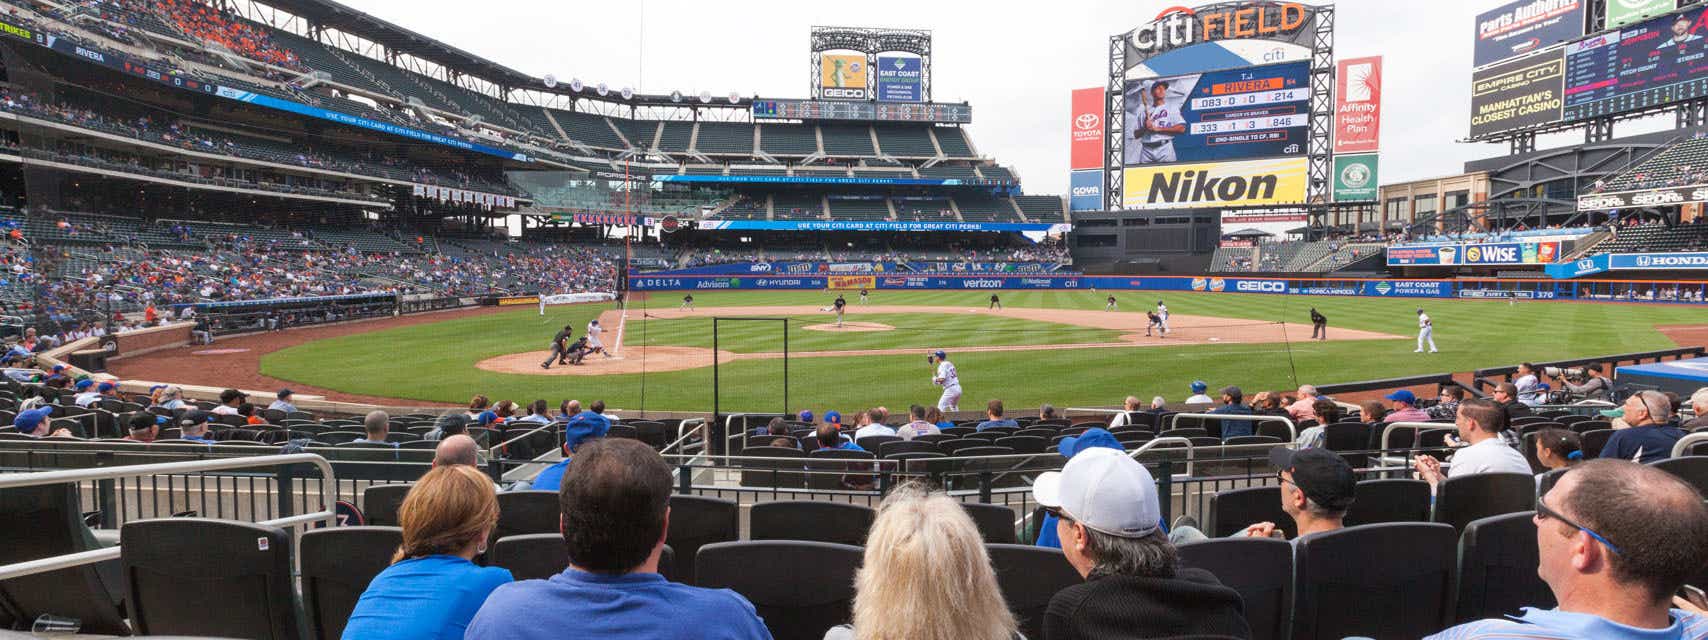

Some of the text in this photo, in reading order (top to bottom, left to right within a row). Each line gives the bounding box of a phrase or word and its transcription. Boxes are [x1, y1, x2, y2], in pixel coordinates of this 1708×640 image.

[1133, 3, 1305, 49] citi FIELD
[1480, 13, 1513, 34] Parts
[76, 46, 105, 62] RIVERA
[1264, 50, 1285, 61] citi
[1477, 65, 1557, 91] EMPIRE CITY
[1224, 79, 1271, 93] RIVERA
[1501, 80, 1530, 91] CASINO
[824, 88, 864, 98] GEICO
[1200, 92, 1294, 108] .083 0 0 .214
[1340, 103, 1377, 113] Affinity
[1480, 90, 1553, 115] MANHATTAN'S
[1342, 114, 1374, 123] Health
[1472, 108, 1517, 126] CLOSEST
[1519, 98, 1561, 116] CASINO
[1199, 123, 1217, 133] .333
[1249, 121, 1256, 129] 3
[1271, 118, 1292, 127] .846
[1347, 125, 1368, 133] Plan
[1284, 145, 1300, 153] citi
[1147, 170, 1278, 204] Nikon
[1482, 247, 1517, 261] WISE
[1653, 256, 1708, 266] HOND
[963, 279, 1001, 288] verizon
[1236, 280, 1285, 291] GEICO
